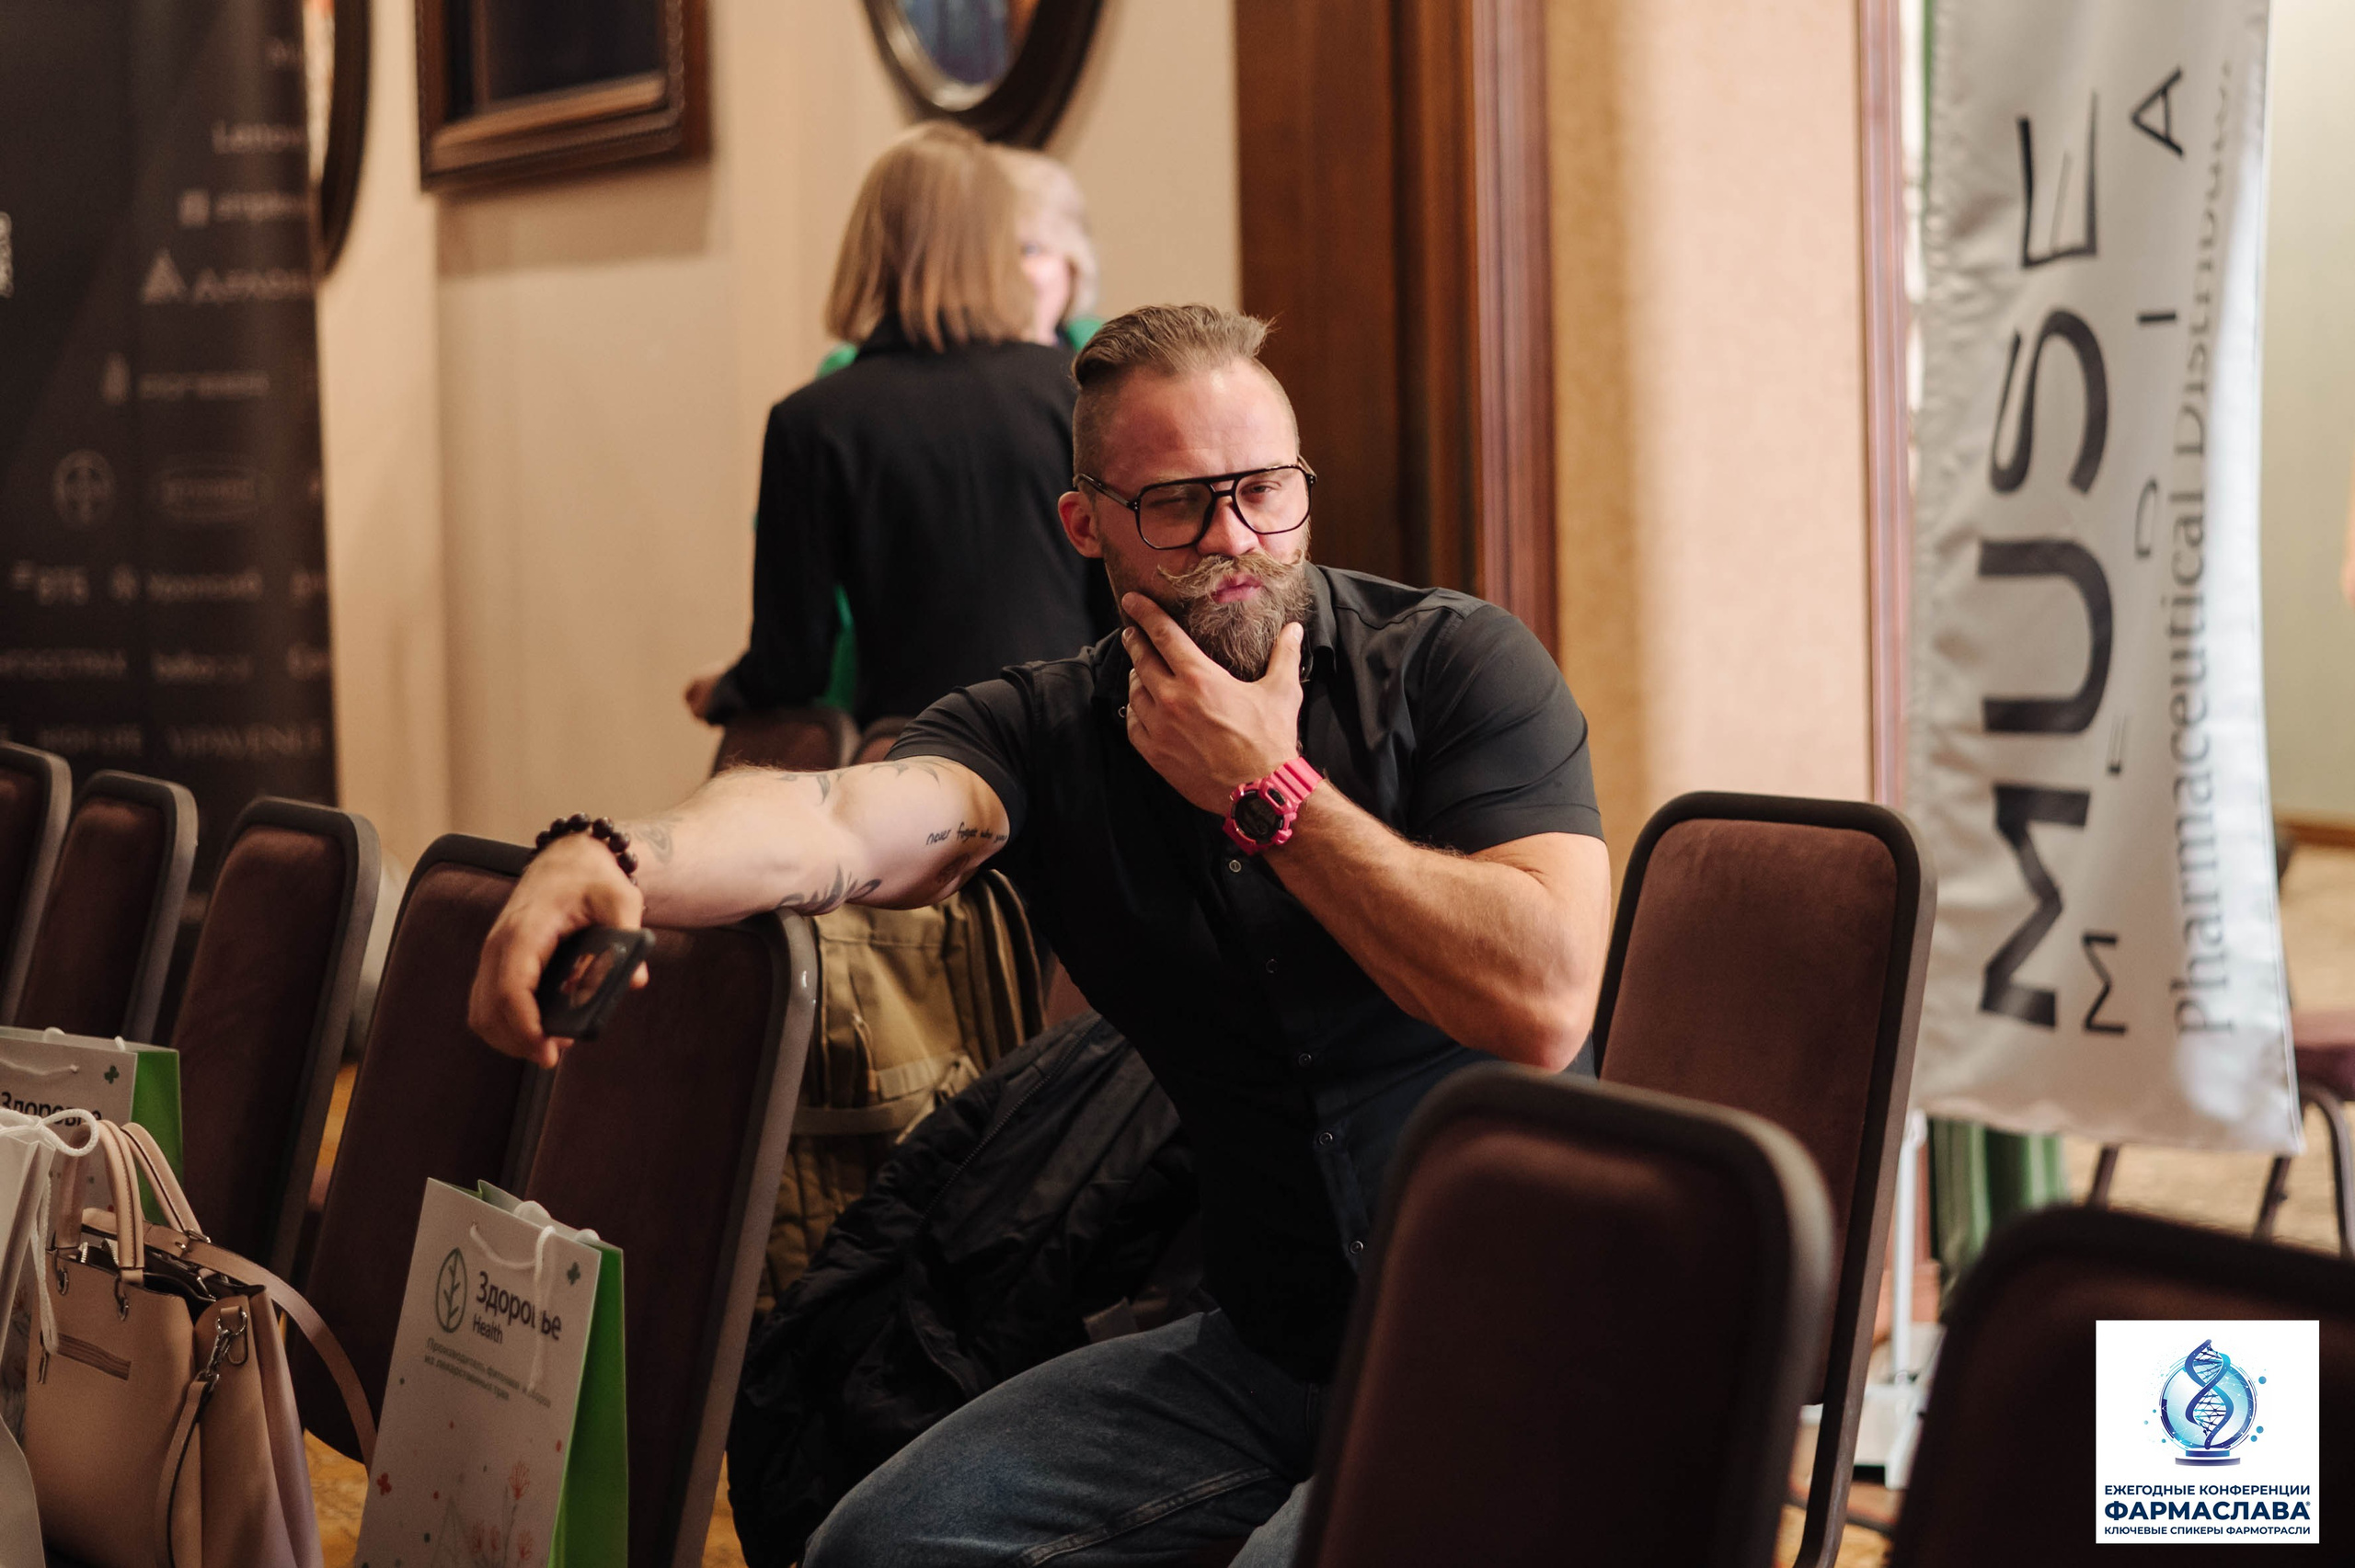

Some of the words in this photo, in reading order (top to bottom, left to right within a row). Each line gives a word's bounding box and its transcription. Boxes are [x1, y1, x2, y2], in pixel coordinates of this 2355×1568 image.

[2174, 57, 2234, 457] Distribu
[1976, 87, 2114, 1033] MUSE
[925, 829, 951, 845] never
[2160, 488, 2235, 1039] Pharmaceutical
[1, 1092, 102, 1127] Здорове
[473, 1314, 503, 1345] Health
